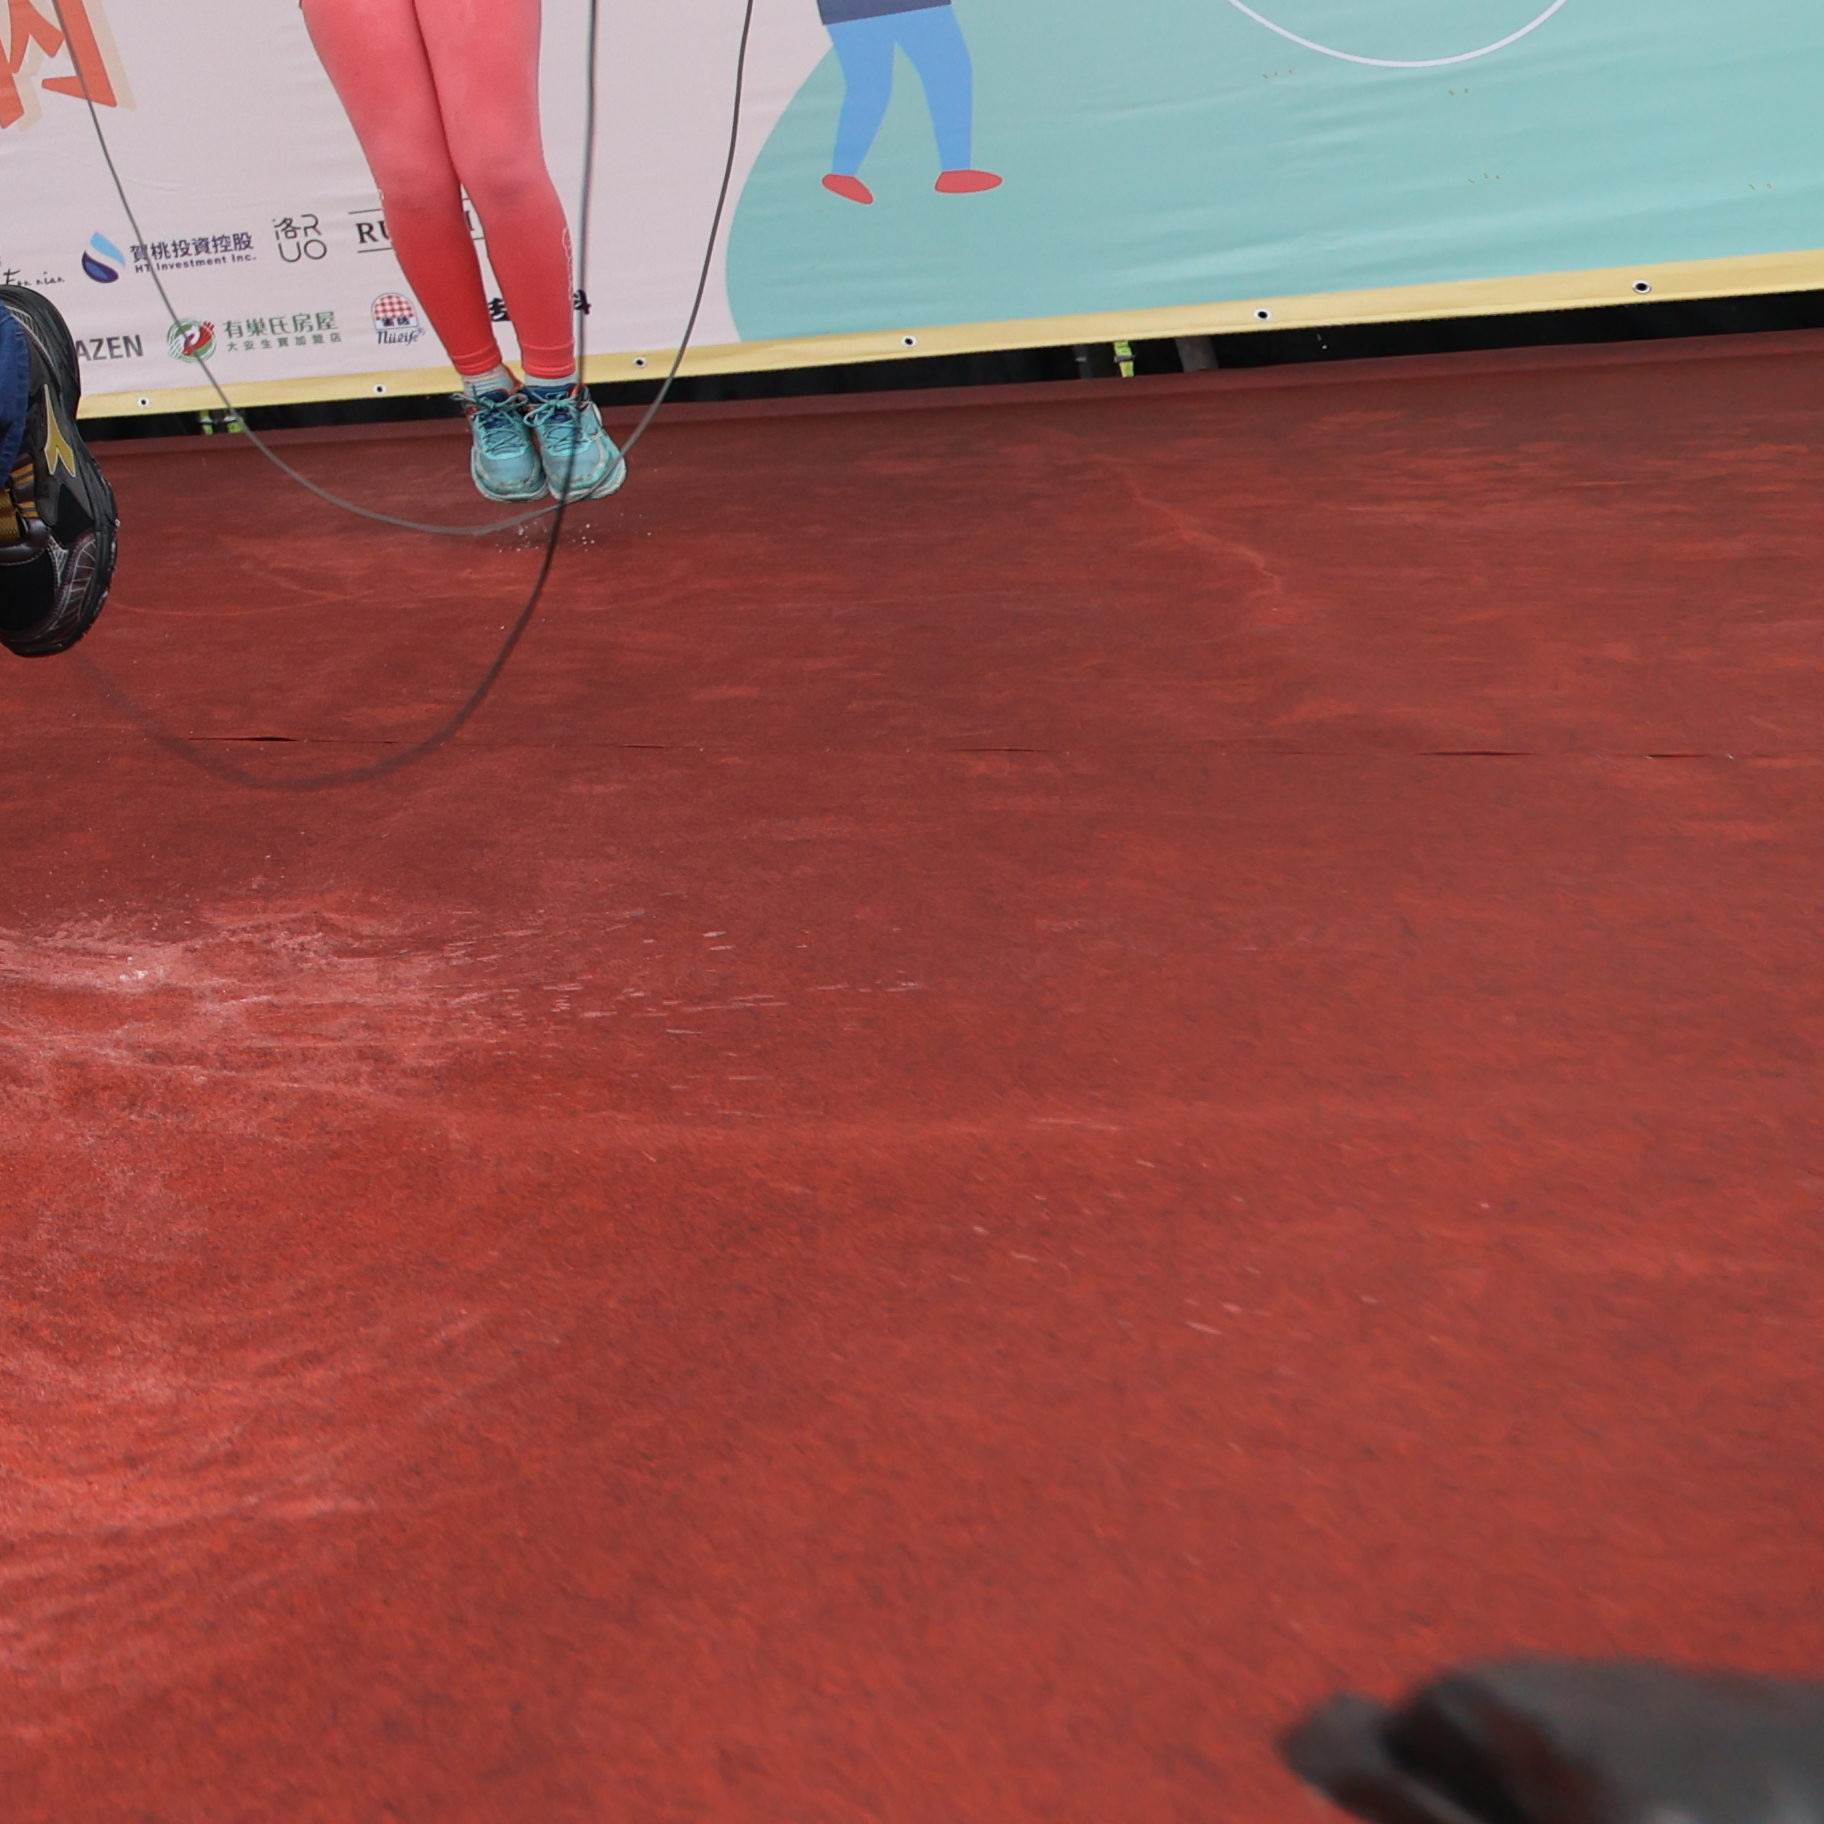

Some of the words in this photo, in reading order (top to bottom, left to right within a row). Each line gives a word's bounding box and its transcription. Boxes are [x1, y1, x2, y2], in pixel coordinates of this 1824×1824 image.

[157, 256, 227, 272] Investment
[231, 253, 257, 263] Inc.
[222, 310, 338, 339] 有巢氏房屋
